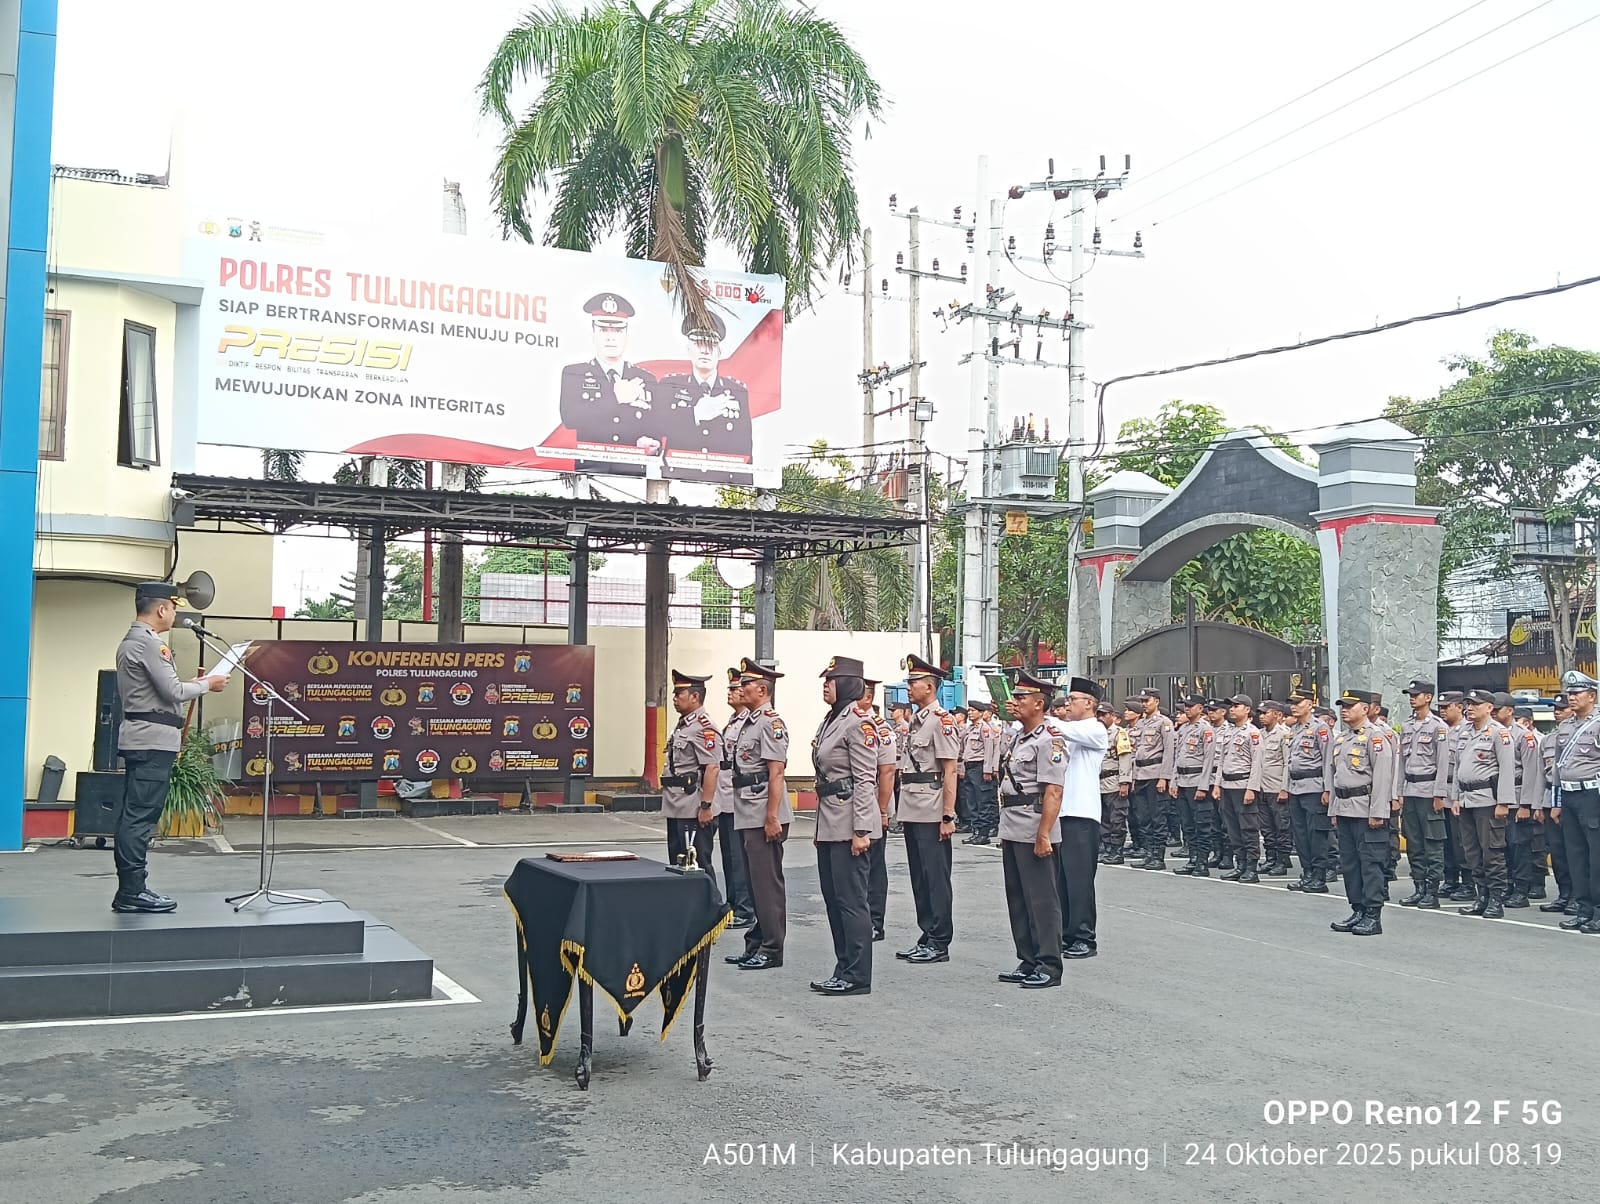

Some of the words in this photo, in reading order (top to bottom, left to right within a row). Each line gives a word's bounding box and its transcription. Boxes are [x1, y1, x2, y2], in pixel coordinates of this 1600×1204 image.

[219, 257, 332, 298] POLRES
[346, 271, 547, 323] TULUNGAGUNG
[219, 299, 260, 316] SIAP
[266, 303, 435, 335] BERTRANSFORMASI
[441, 323, 510, 344] MENUJU
[515, 331, 560, 349] POLRI
[217, 324, 414, 371] PRESISI
[215, 377, 348, 402] MEWUJUDKAN
[355, 389, 404, 408] ZONA
[410, 395, 506, 417] INTEGRITAS
[347, 651, 459, 667] KONFERENSI
[463, 653, 505, 668] PERS
[376, 669, 408, 677] POLRES
[410, 669, 478, 678] TULUNGAGUNG
[307, 689, 372, 697] TULUNGAGUNG
[502, 692, 554, 701] PRESISI
[430, 723, 491, 731] TULUNGAGUNG
[505, 758, 559, 767] PRESISI
